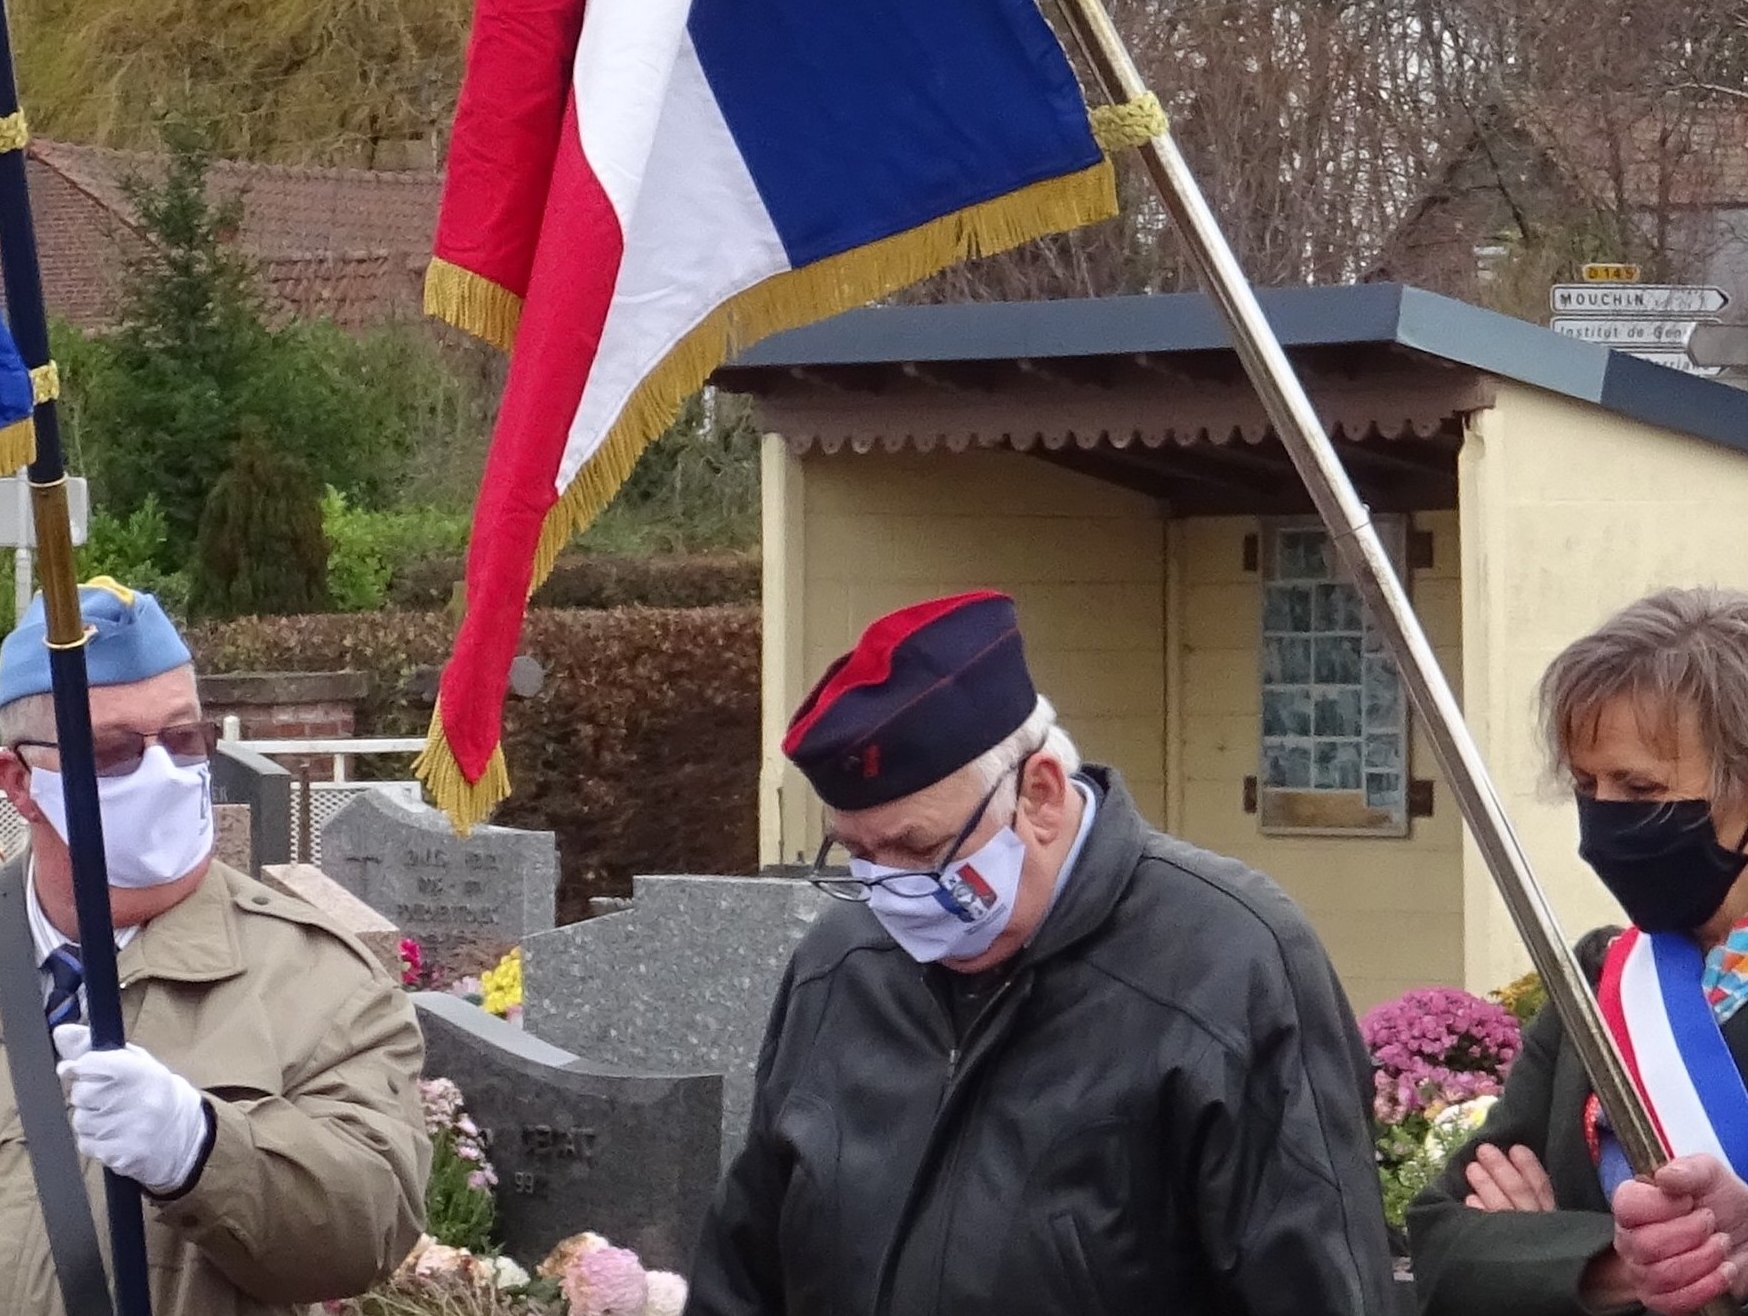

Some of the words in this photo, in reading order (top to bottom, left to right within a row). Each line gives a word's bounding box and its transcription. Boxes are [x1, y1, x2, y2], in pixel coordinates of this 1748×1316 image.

[1560, 292, 1644, 307] MOUCHIN
[1560, 326, 1619, 339] Institut
[1627, 328, 1646, 339] de
